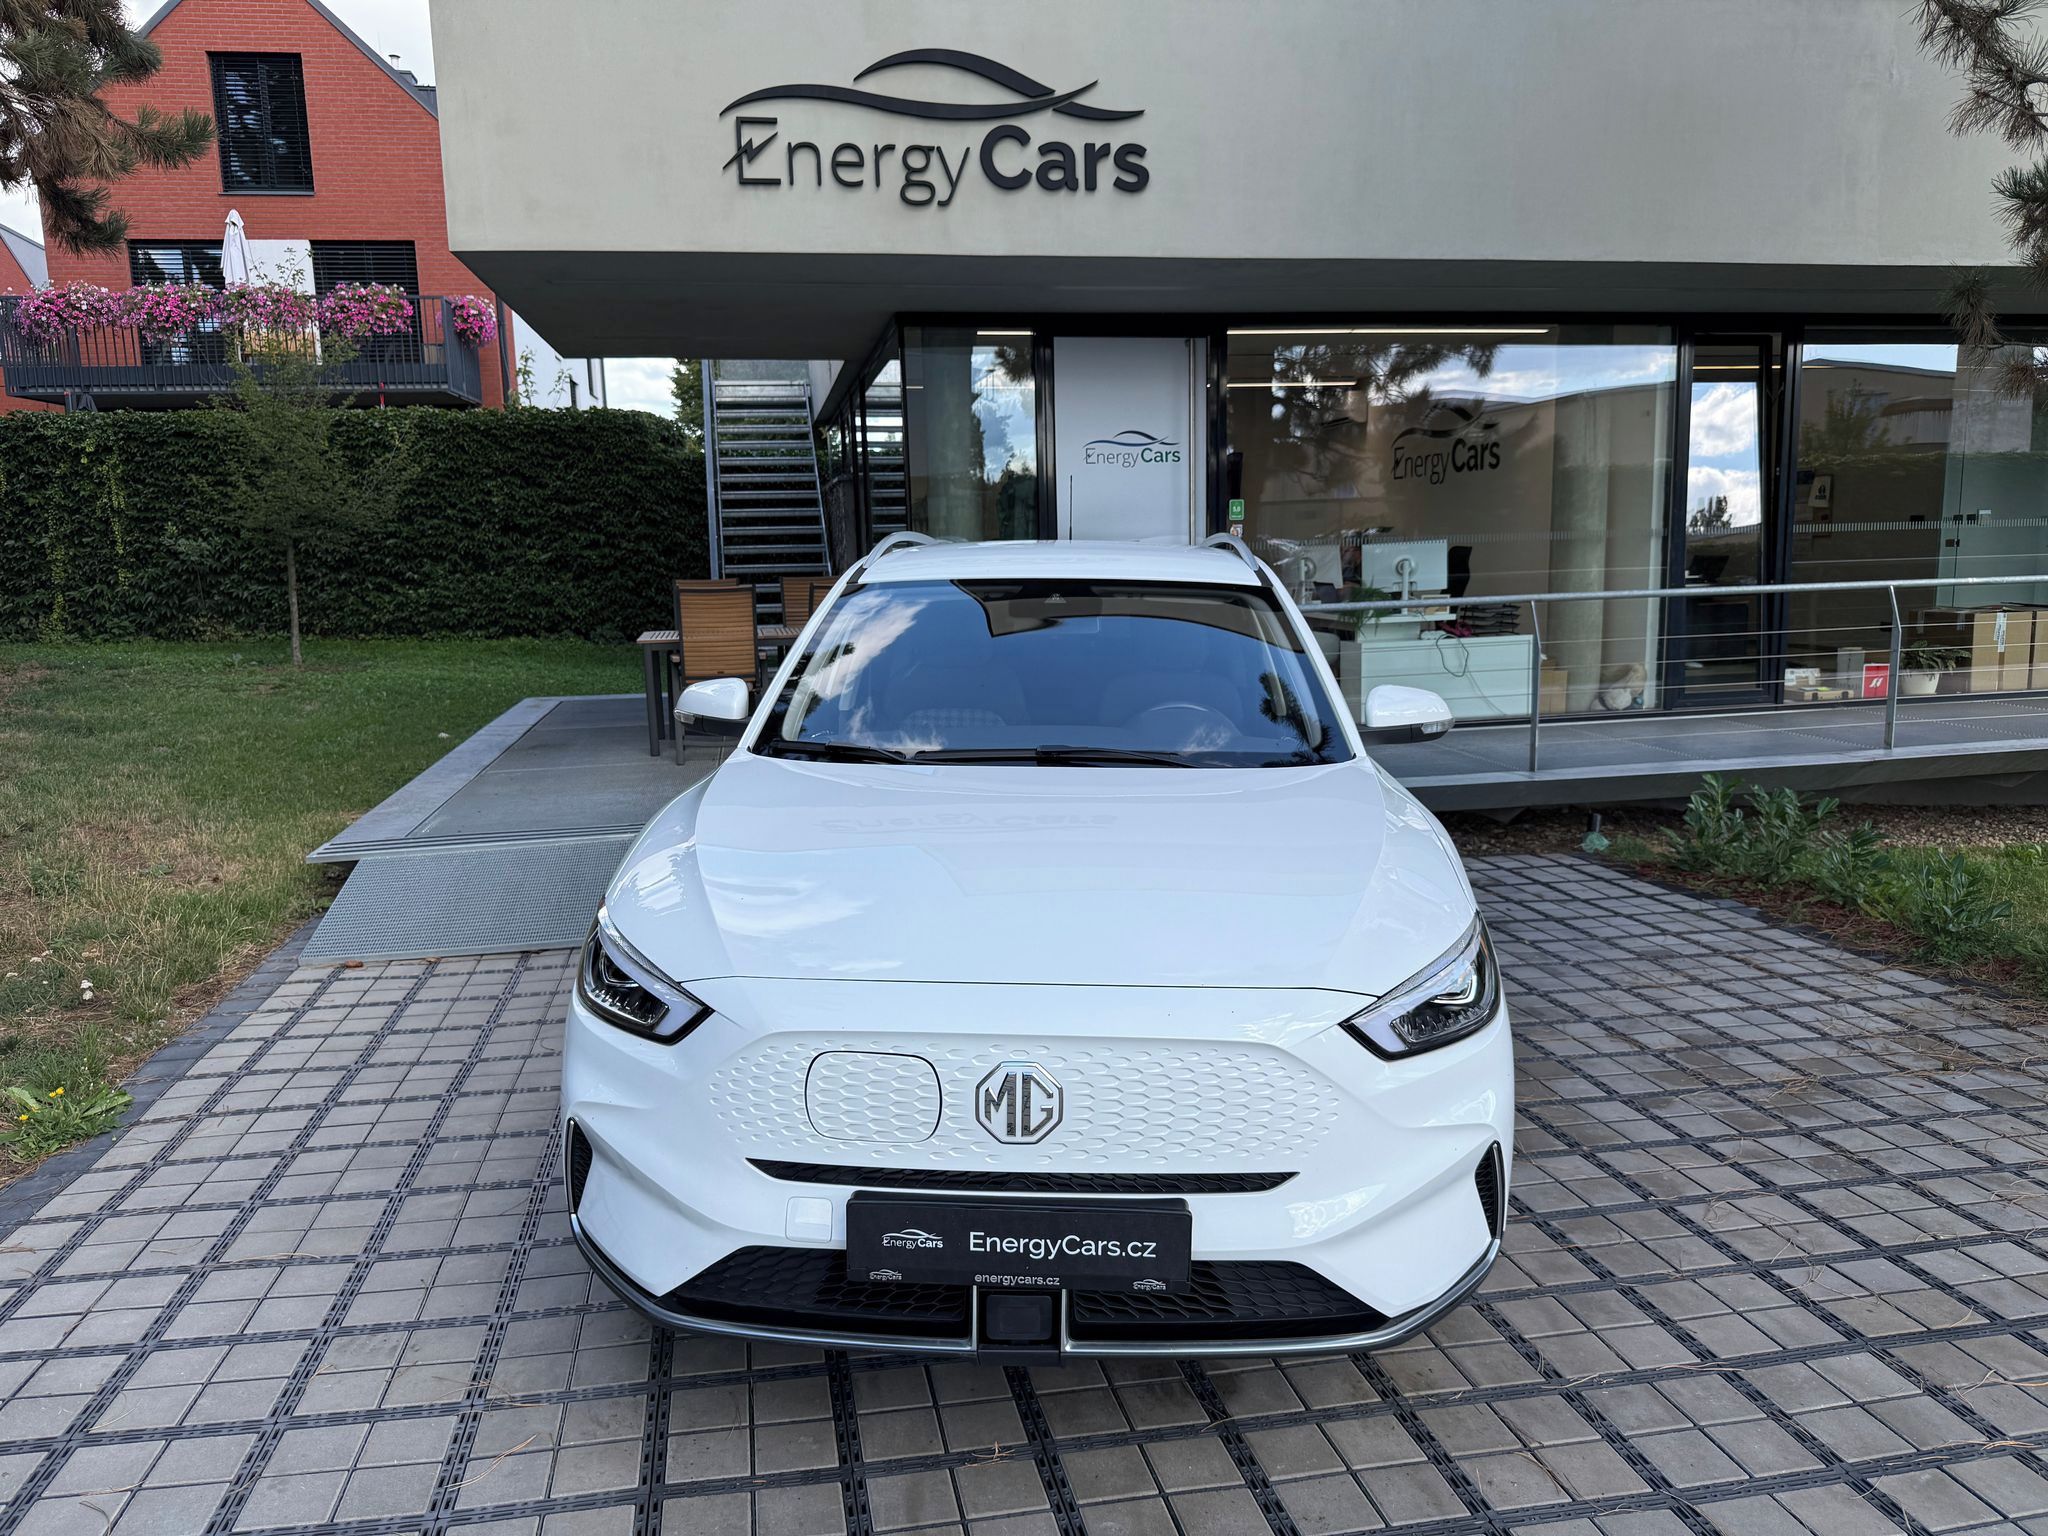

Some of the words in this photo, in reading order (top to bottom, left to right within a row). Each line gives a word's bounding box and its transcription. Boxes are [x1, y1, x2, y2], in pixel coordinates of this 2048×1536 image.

[984, 1072, 1053, 1137] MG
[969, 1231, 1157, 1260] EnergyCars.cz
[974, 1274, 1060, 1286] energycars.cz
